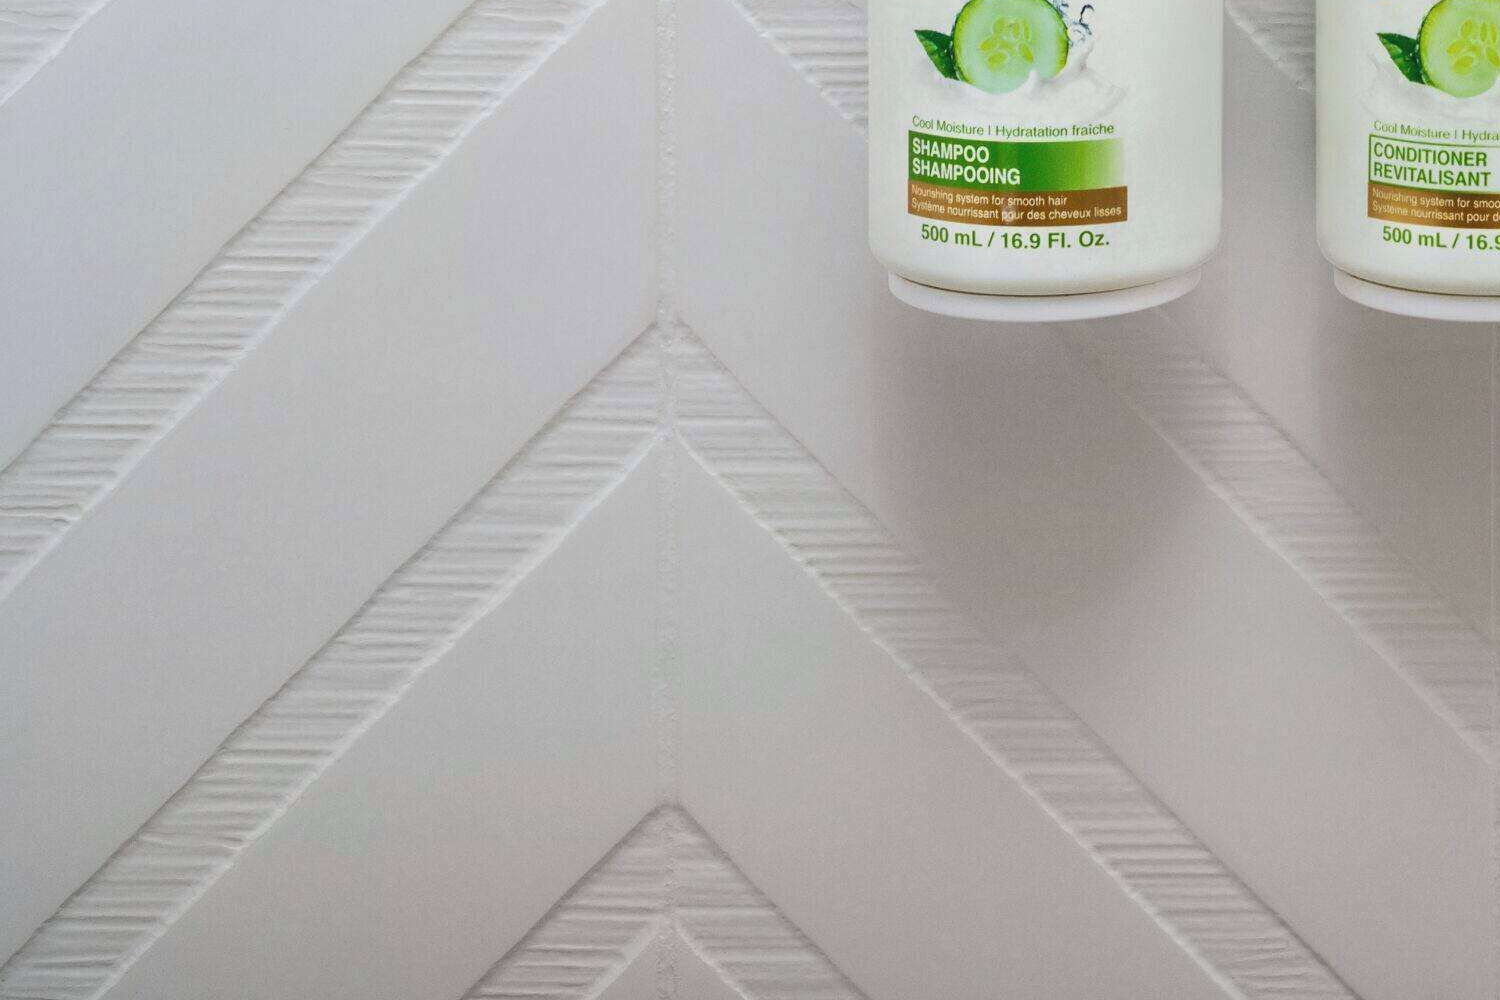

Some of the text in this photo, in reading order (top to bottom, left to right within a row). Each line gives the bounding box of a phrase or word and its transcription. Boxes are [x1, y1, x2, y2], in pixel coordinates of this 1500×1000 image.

[912, 115, 933, 129] Cool
[937, 121, 983, 135] Moisture
[996, 124, 1067, 139] Hydratation
[1374, 120, 1397, 134] Cool
[1400, 124, 1450, 139] Moisture
[912, 137, 990, 163] SHAMPOO
[1374, 143, 1487, 167] CONDITIONER
[912, 158, 1020, 184] SHAMPOOING
[1374, 163, 1491, 186] REVITALISANT
[912, 185, 1067, 206] Nourishing system for smooth hair
[1373, 188, 1417, 206] Nourishing
[1420, 196, 1454, 208] system
[1457, 198, 1470, 208] for
[948, 206, 998, 219] nourrissant
[1002, 210, 1023, 222] pour
[1028, 207, 1045, 219] des
[1048, 207, 1091, 219] cheveux
[1094, 207, 1121, 217] lisses
[1411, 207, 1464, 221] nourrissant
[1466, 212, 1489, 223] pour
[921, 224, 1109, 249] 500 mL / 16.9 Fl. Oz.
[1383, 226, 1411, 245] 500
[1419, 233, 1446, 248] mL
[1452, 233, 1459, 249] /
